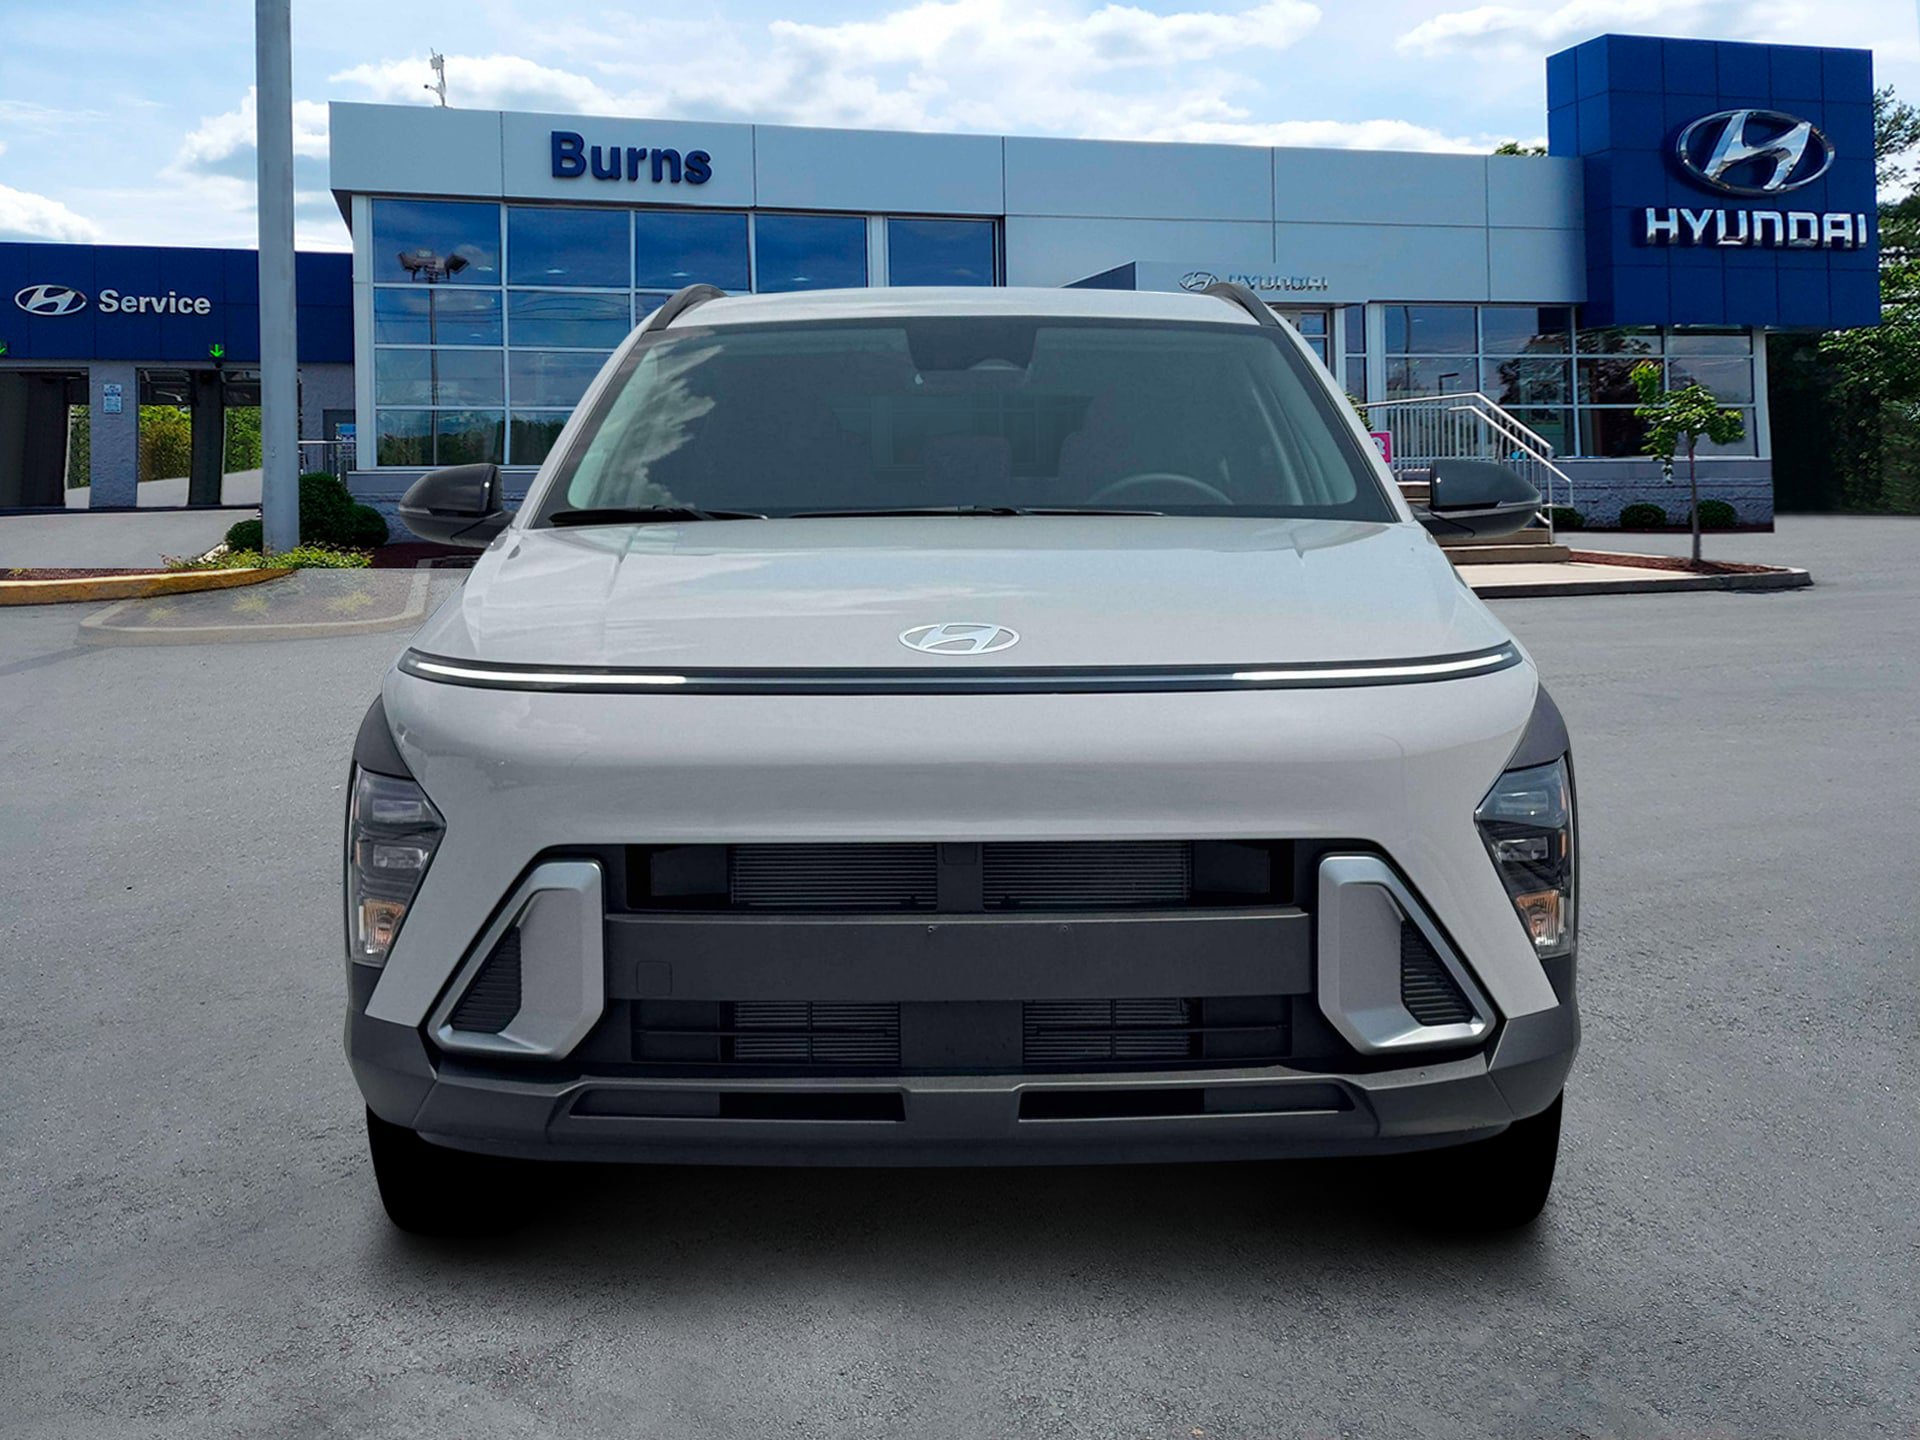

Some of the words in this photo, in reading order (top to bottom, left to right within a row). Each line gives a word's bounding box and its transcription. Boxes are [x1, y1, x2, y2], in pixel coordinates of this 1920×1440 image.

[551, 131, 712, 184] Burns
[1645, 207, 1868, 248] HYUNDAI
[99, 289, 211, 314] Service
